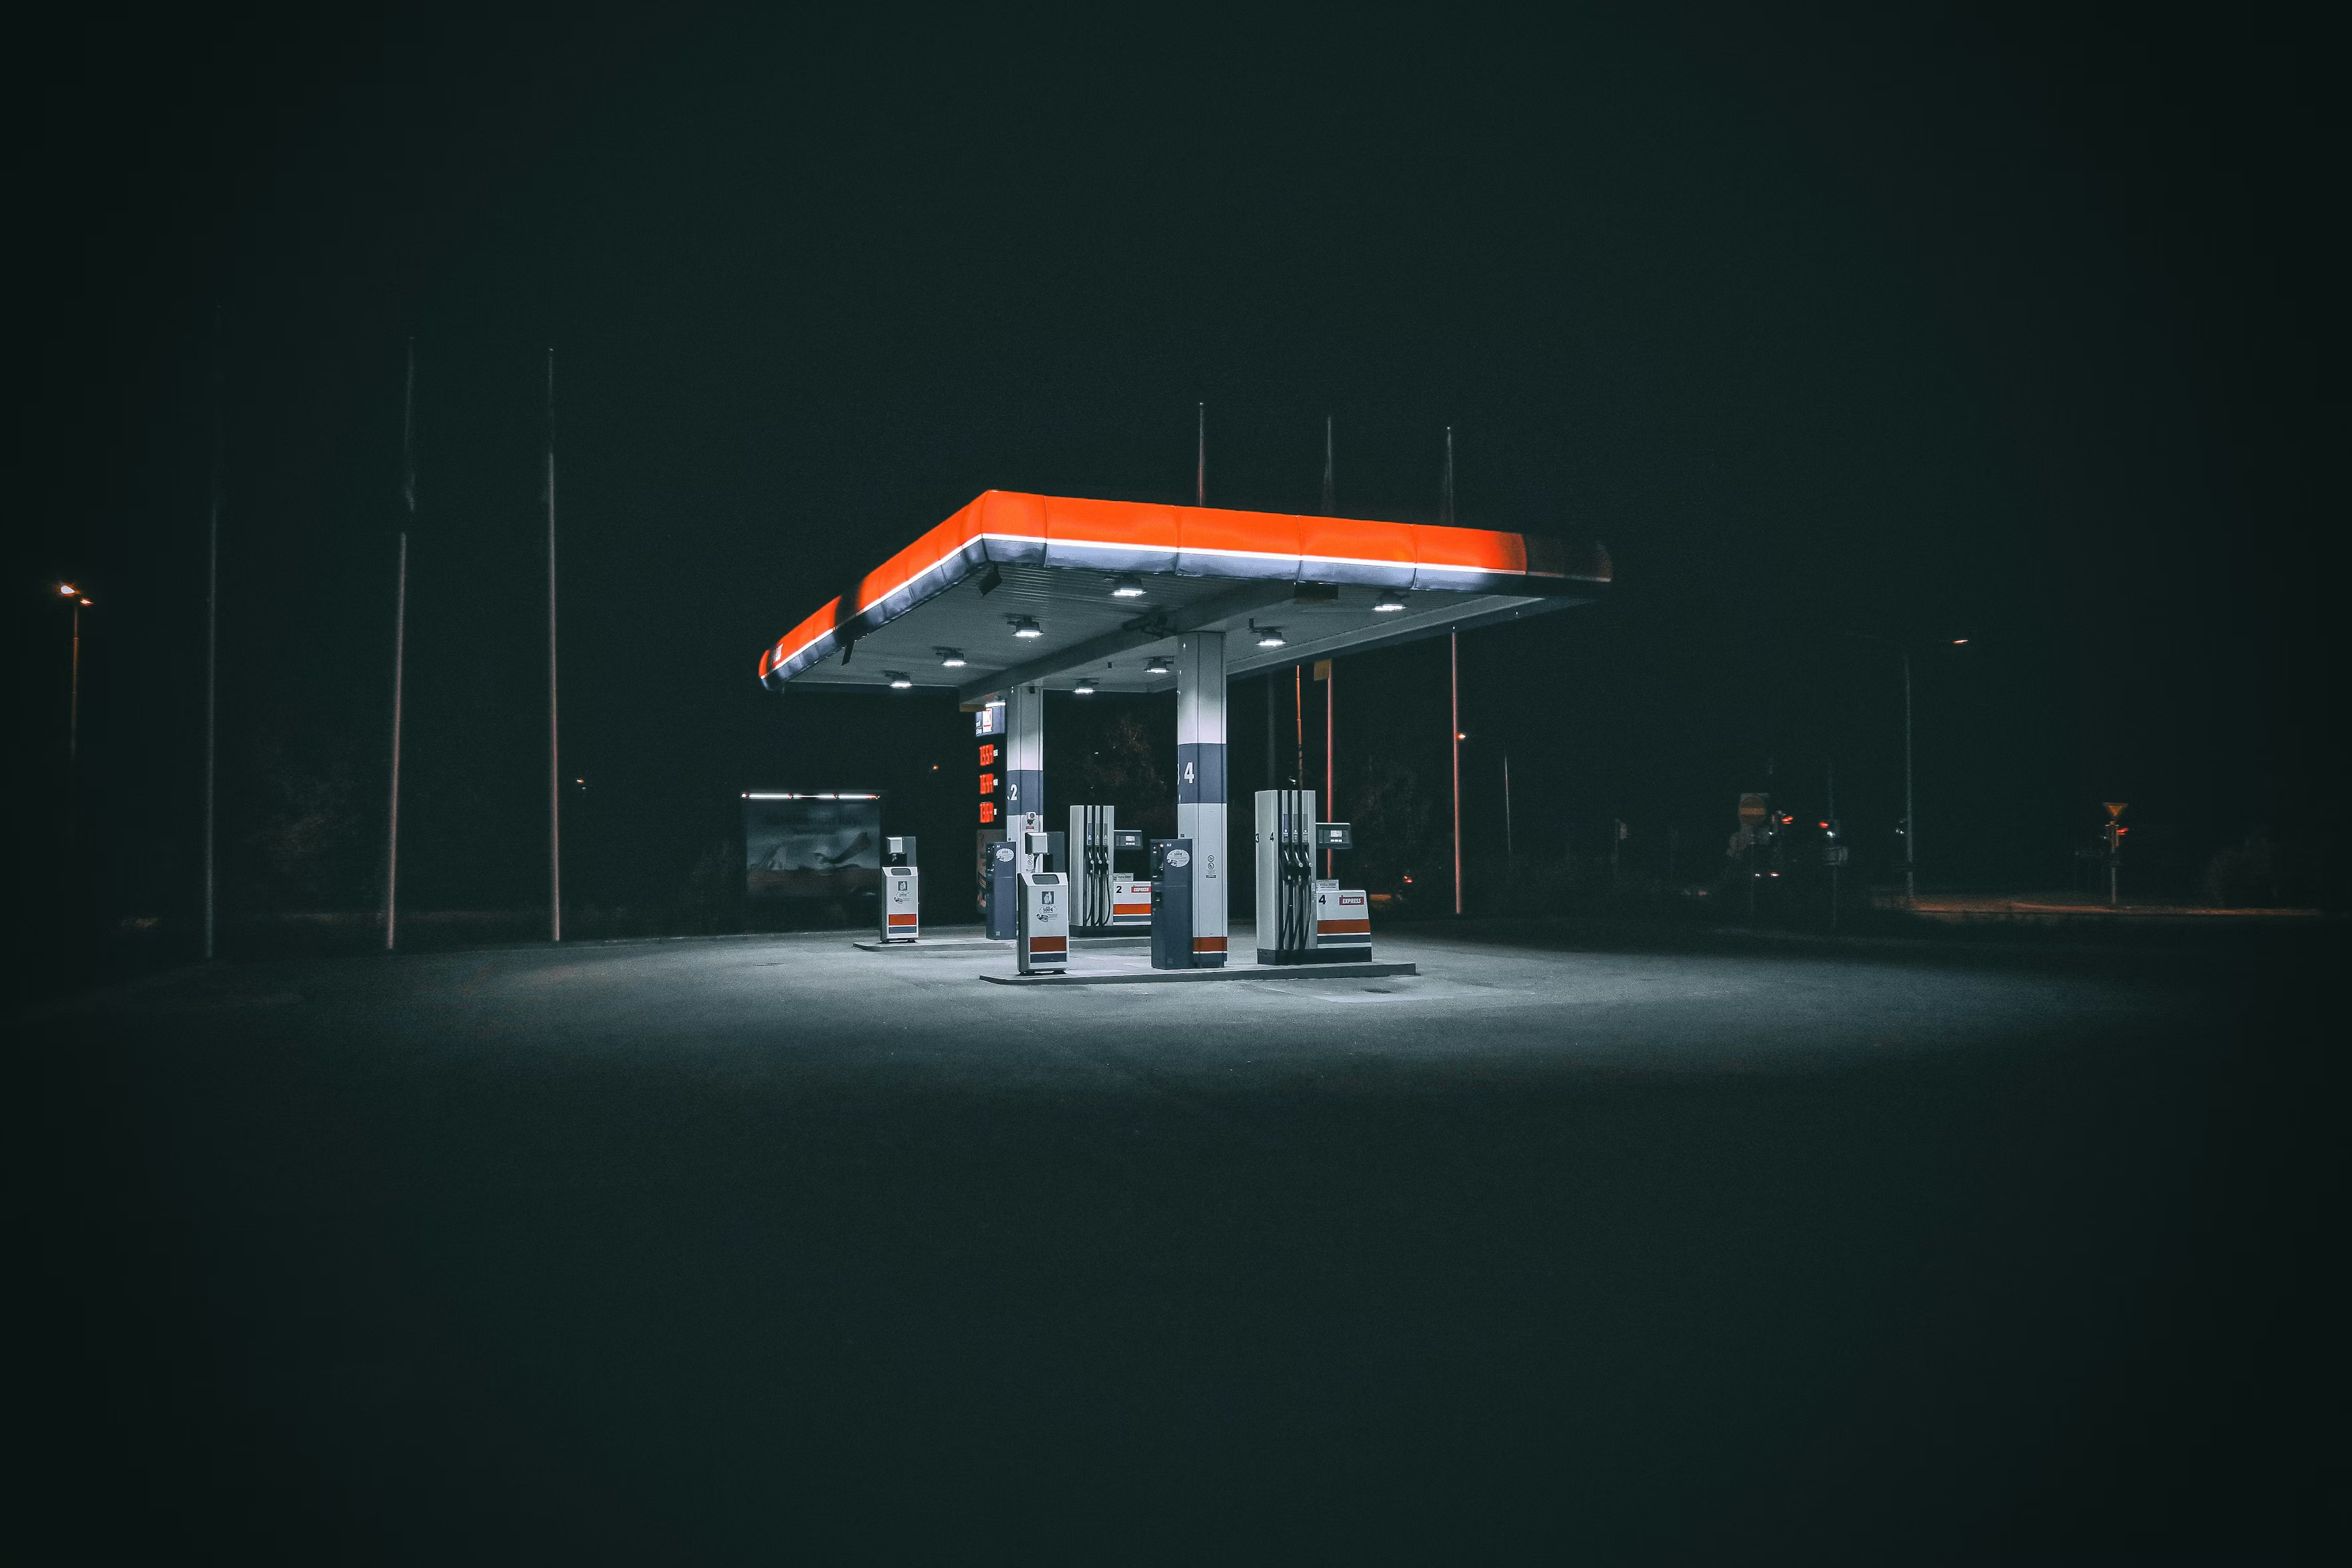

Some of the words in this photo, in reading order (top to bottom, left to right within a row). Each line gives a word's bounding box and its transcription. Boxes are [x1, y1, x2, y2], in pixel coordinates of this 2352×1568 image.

[1184, 762, 1195, 783] 4
[1010, 784, 1018, 801] 2
[1255, 833, 1260, 843] 3
[1270, 832, 1274, 842] 4
[1319, 894, 1326, 905] 4
